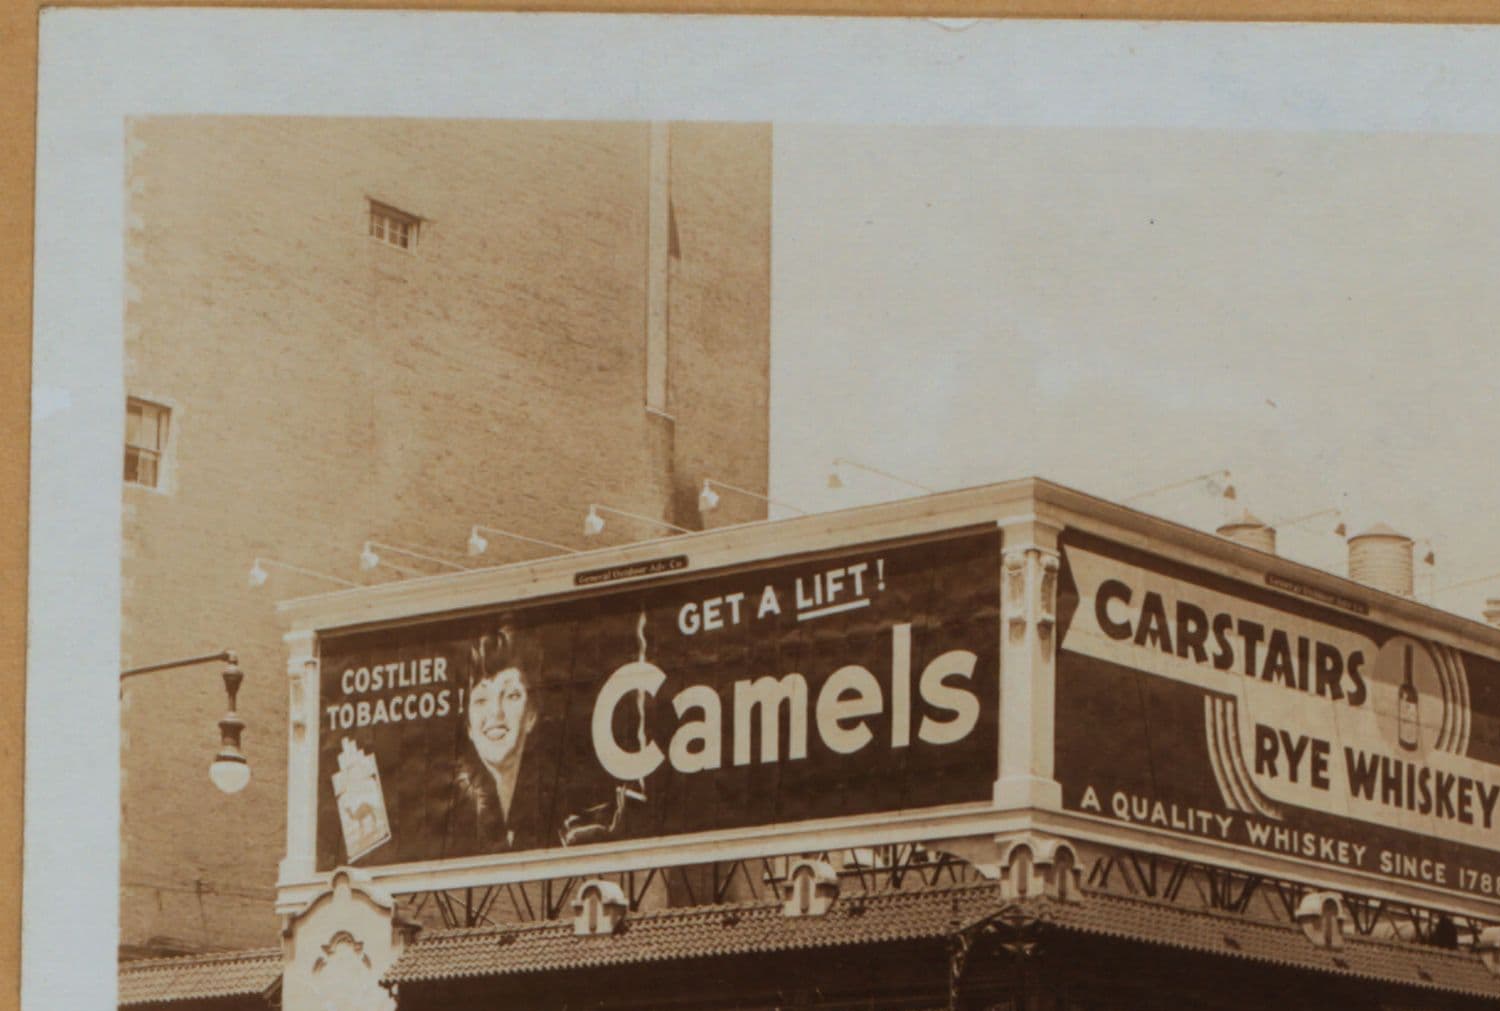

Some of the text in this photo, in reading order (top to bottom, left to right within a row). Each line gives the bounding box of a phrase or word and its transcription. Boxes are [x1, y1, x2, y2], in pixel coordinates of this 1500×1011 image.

[679, 591, 745, 635] GET
[757, 585, 780, 619] A
[1094, 578, 1367, 706] CARSTAIRS
[341, 656, 448, 694] COSTLIER
[591, 622, 981, 781] Camels
[1254, 723, 1500, 830] RYE WHISKEY
[1081, 786, 1101, 812] A
[1112, 791, 1233, 838] QUALITY
[1246, 820, 1367, 866] WHISKEY
[1380, 849, 1446, 884] SINCE
